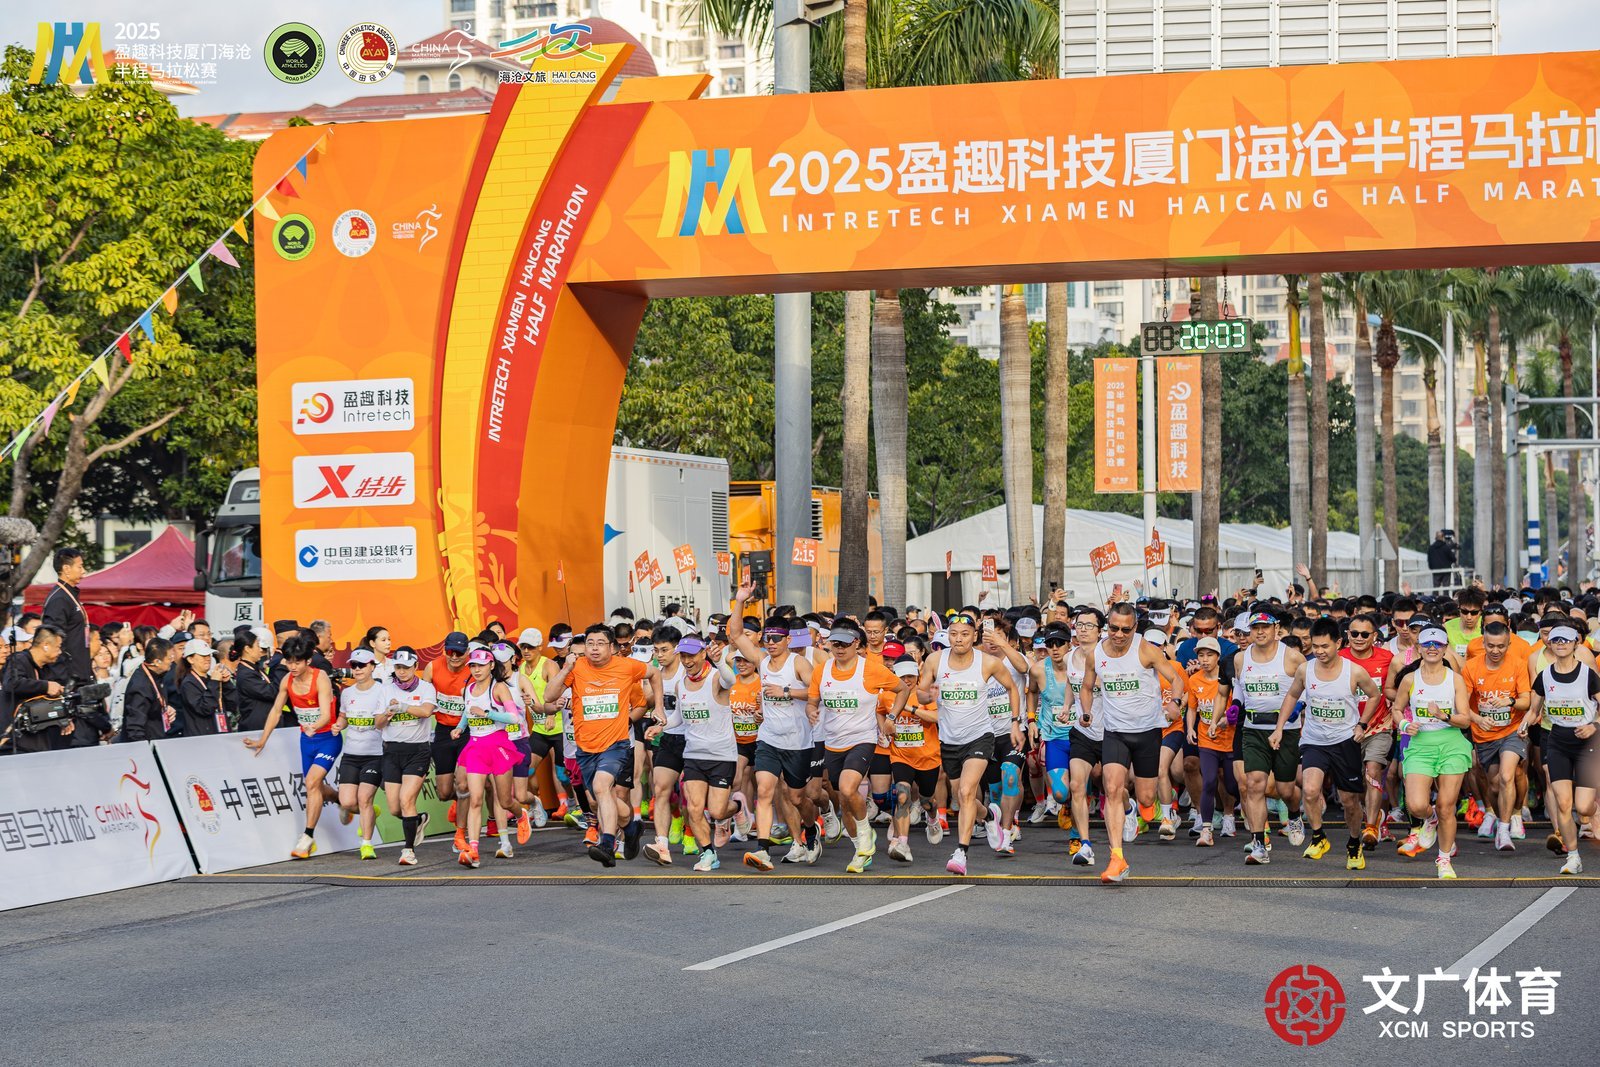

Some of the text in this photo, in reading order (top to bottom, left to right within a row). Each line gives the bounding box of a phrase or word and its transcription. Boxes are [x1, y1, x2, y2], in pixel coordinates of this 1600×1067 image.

[782, 206, 971, 233] INTRETECH
[1001, 199, 1135, 225] XIAMEN
[1168, 188, 1328, 216] HAICANG
[1362, 184, 1450, 206] HALF
[392, 222, 422, 231] CHINA
[523, 183, 590, 346] HALF MARATHON
[488, 219, 552, 443] INTRETECH XIAMEN HAICANG
[343, 389, 410, 408] 盈趣科技
[343, 408, 411, 423] Intretech
[1170, 402, 1188, 479] 盈趣科技
[352, 476, 408, 498] 特步
[324, 544, 414, 558] 中国建设银行
[793, 547, 815, 563] 2:15
[345, 558, 385, 566] Construction
[676, 553, 694, 570] 2:45
[1100, 551, 1118, 569] 2:30
[1105, 681, 1137, 691] C18502
[1247, 683, 1277, 691] C18528
[943, 691, 975, 700] C20968
[437, 701, 465, 711] C21669
[585, 703, 617, 714] C25717
[825, 699, 856, 708] C18512
[683, 710, 708, 719] C18515
[1311, 708, 1343, 718] C18520
[1549, 707, 1583, 716] C18805
[94, 802, 135, 823] CHINA
